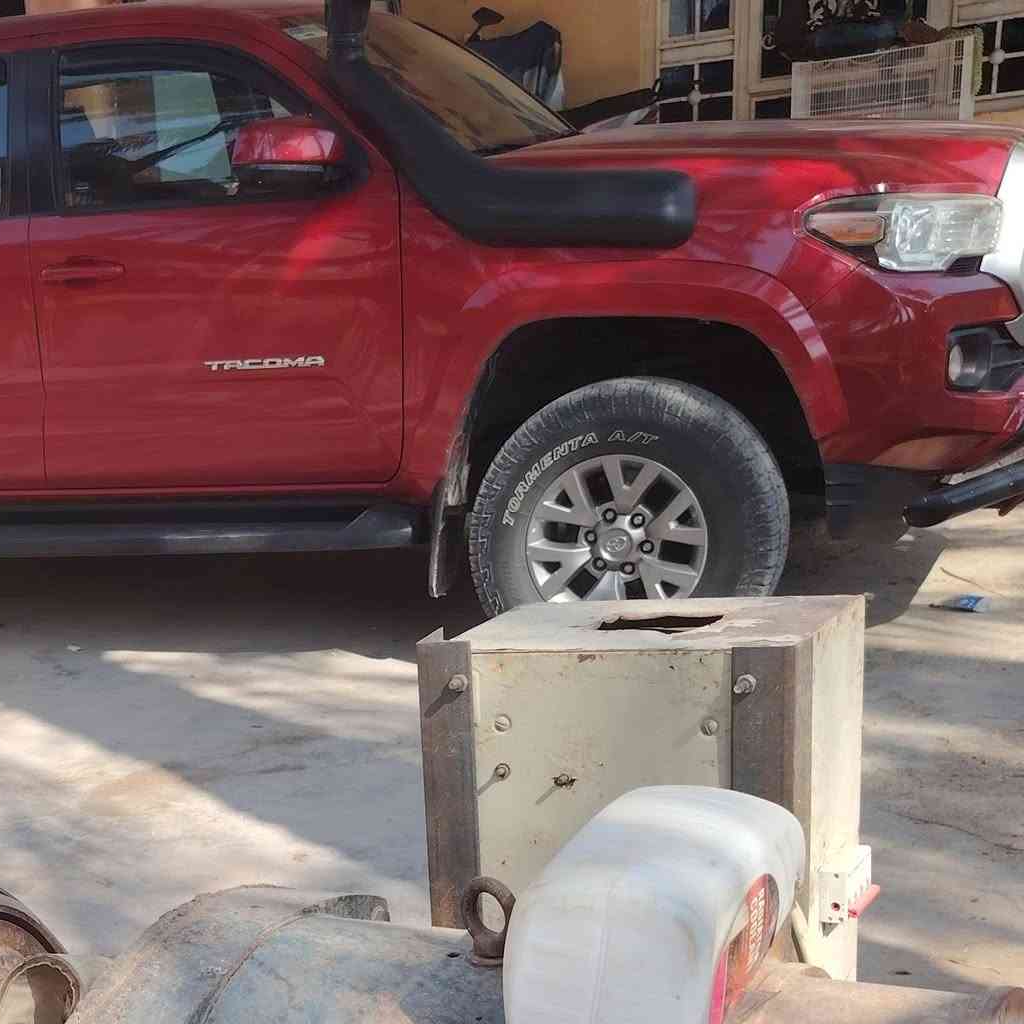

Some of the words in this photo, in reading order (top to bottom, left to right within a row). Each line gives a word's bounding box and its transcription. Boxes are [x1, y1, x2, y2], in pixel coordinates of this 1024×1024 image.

[203, 355, 326, 371] TACOMA
[502, 431, 599, 527] TORMENTA
[608, 430, 660, 444] A/T
